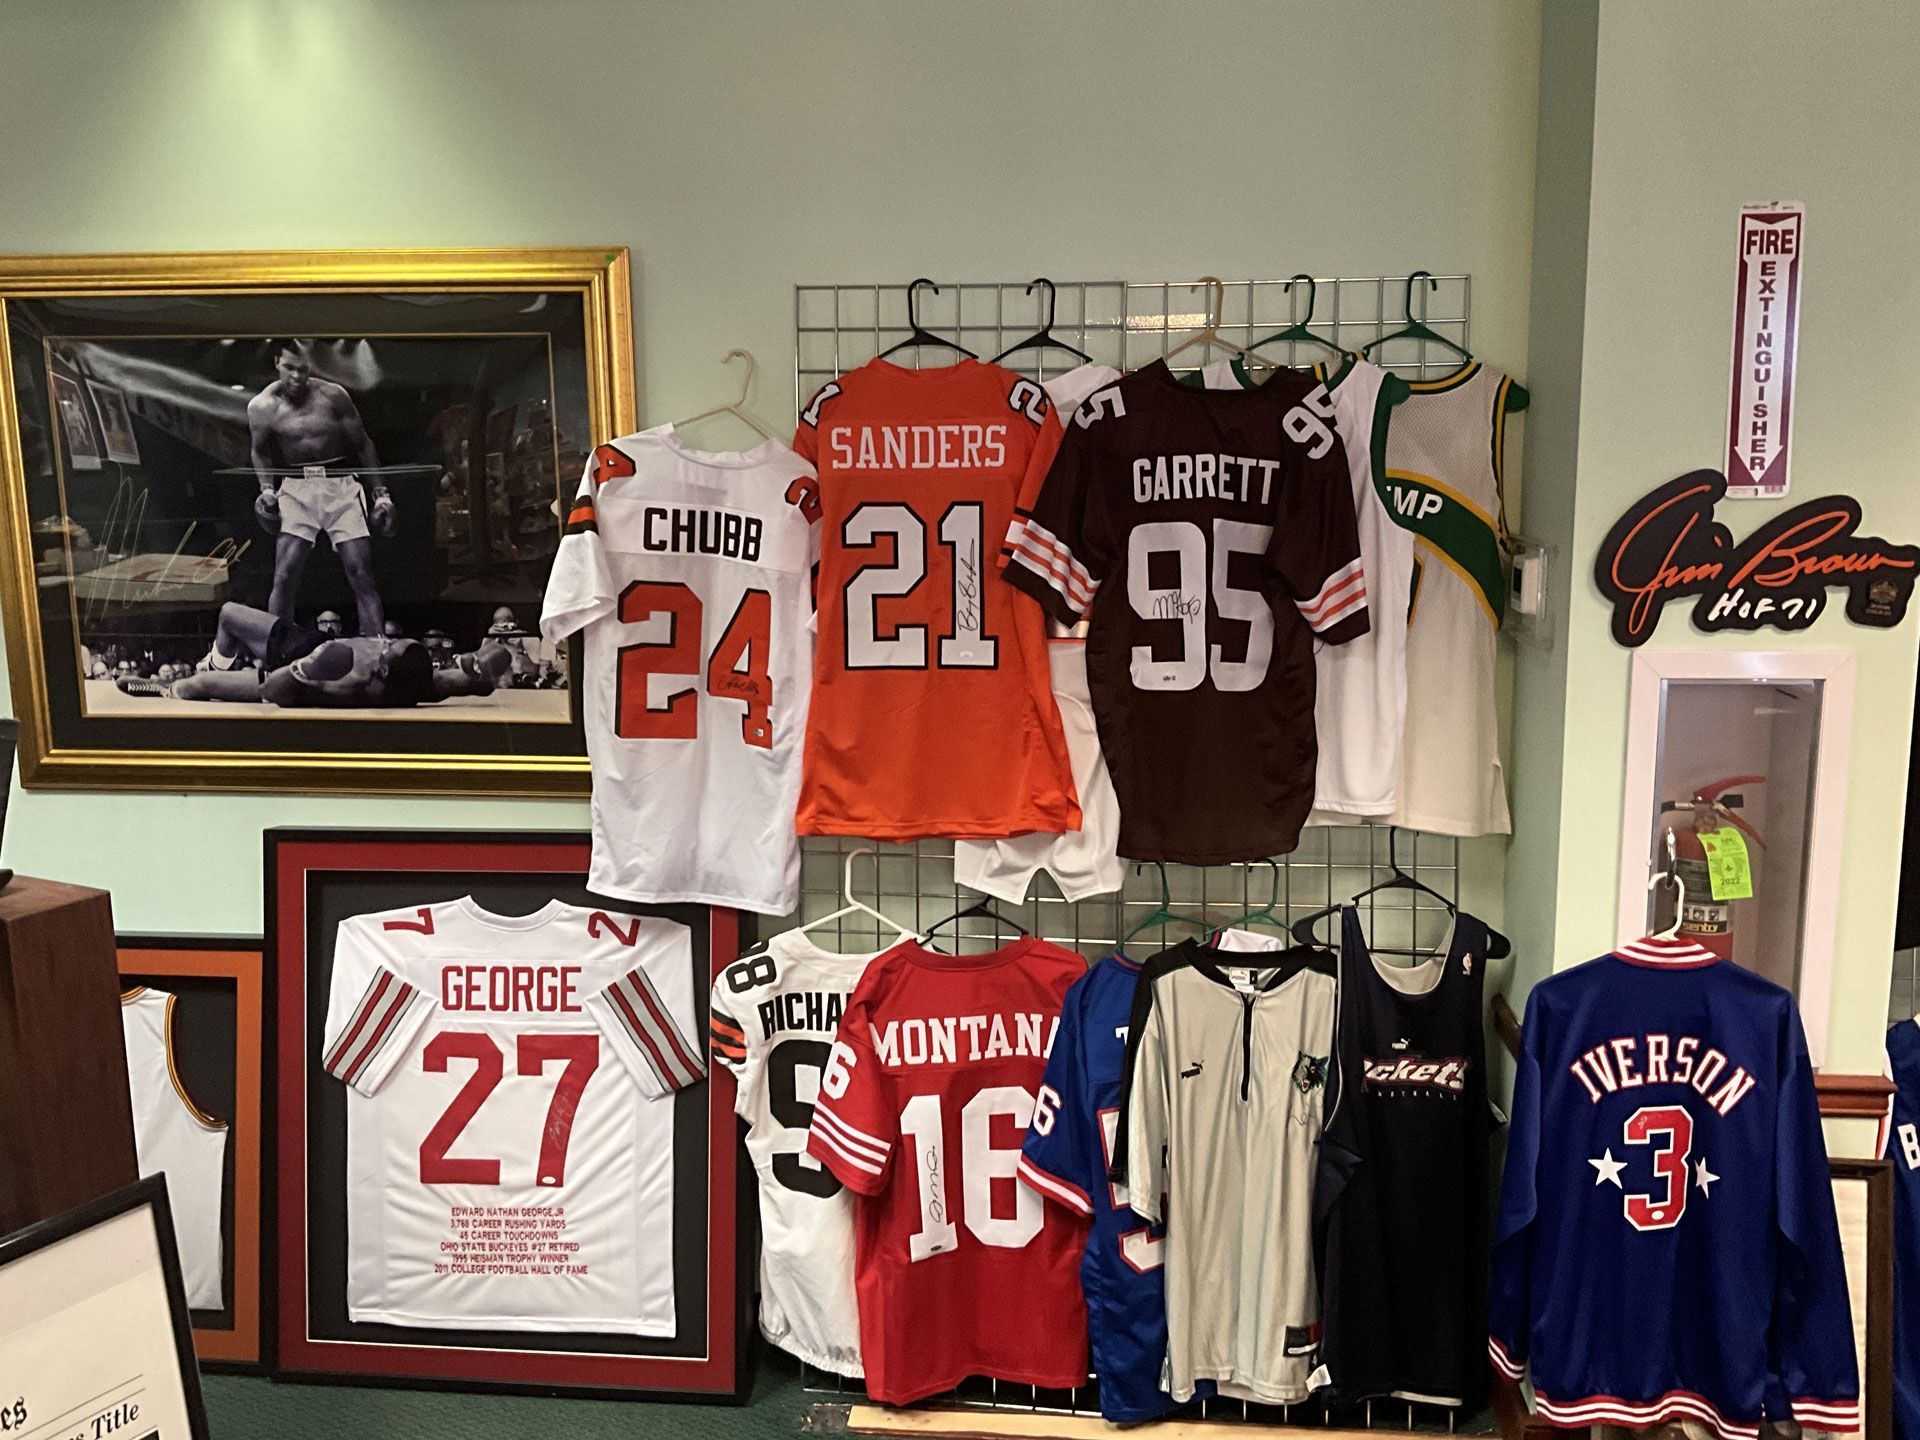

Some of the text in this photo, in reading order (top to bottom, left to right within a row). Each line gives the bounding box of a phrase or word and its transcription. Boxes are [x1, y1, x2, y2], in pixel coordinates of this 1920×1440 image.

[1746, 229, 1794, 255] FIRE
[1750, 261, 1776, 471] EXTINGUISHER
[831, 425, 1007, 469] SANDERS
[1133, 454, 1280, 504] GARRETT
[1386, 485, 1443, 520] MP
[643, 507, 763, 562] CHUBB
[1611, 485, 1915, 635] Jim Brown
[841, 502, 1000, 671] 21
[1127, 518, 1276, 693] 95
[1782, 599, 1817, 619] 71
[615, 580, 774, 750] 24
[441, 965, 583, 1012] GEORGE
[758, 992, 855, 1041] RICHA
[822, 1041, 857, 1100] 6
[1363, 1059, 1467, 1090] ckets
[1571, 1034, 1757, 1118] IVERSON
[419, 1031, 600, 1188] 27
[1032, 1084, 1063, 1137] 6
[900, 1085, 1045, 1263] 16
[1623, 1105, 1695, 1232] 3
[451, 1207, 485, 1217] EDWARD
[487, 1208, 519, 1217] NATHAN
[471, 1231, 501, 1240] CAREER
[504, 1231, 559, 1241] TOUCHDOWNS
[472, 1219, 502, 1229] CAREER
[505, 1219, 538, 1229] RUSHING
[541, 1219, 567, 1229] YARDS
[434, 1264, 588, 1275] 2011 COLLEGE FOOTBALL HALL OF FAME
[440, 1242, 580, 1252] OHIO STATE BUCKEYES #27 RETIRED
[452, 1253, 569, 1263] 1995 HEISMAN TROPHY WINNER
[90, 1402, 140, 1440] Title
